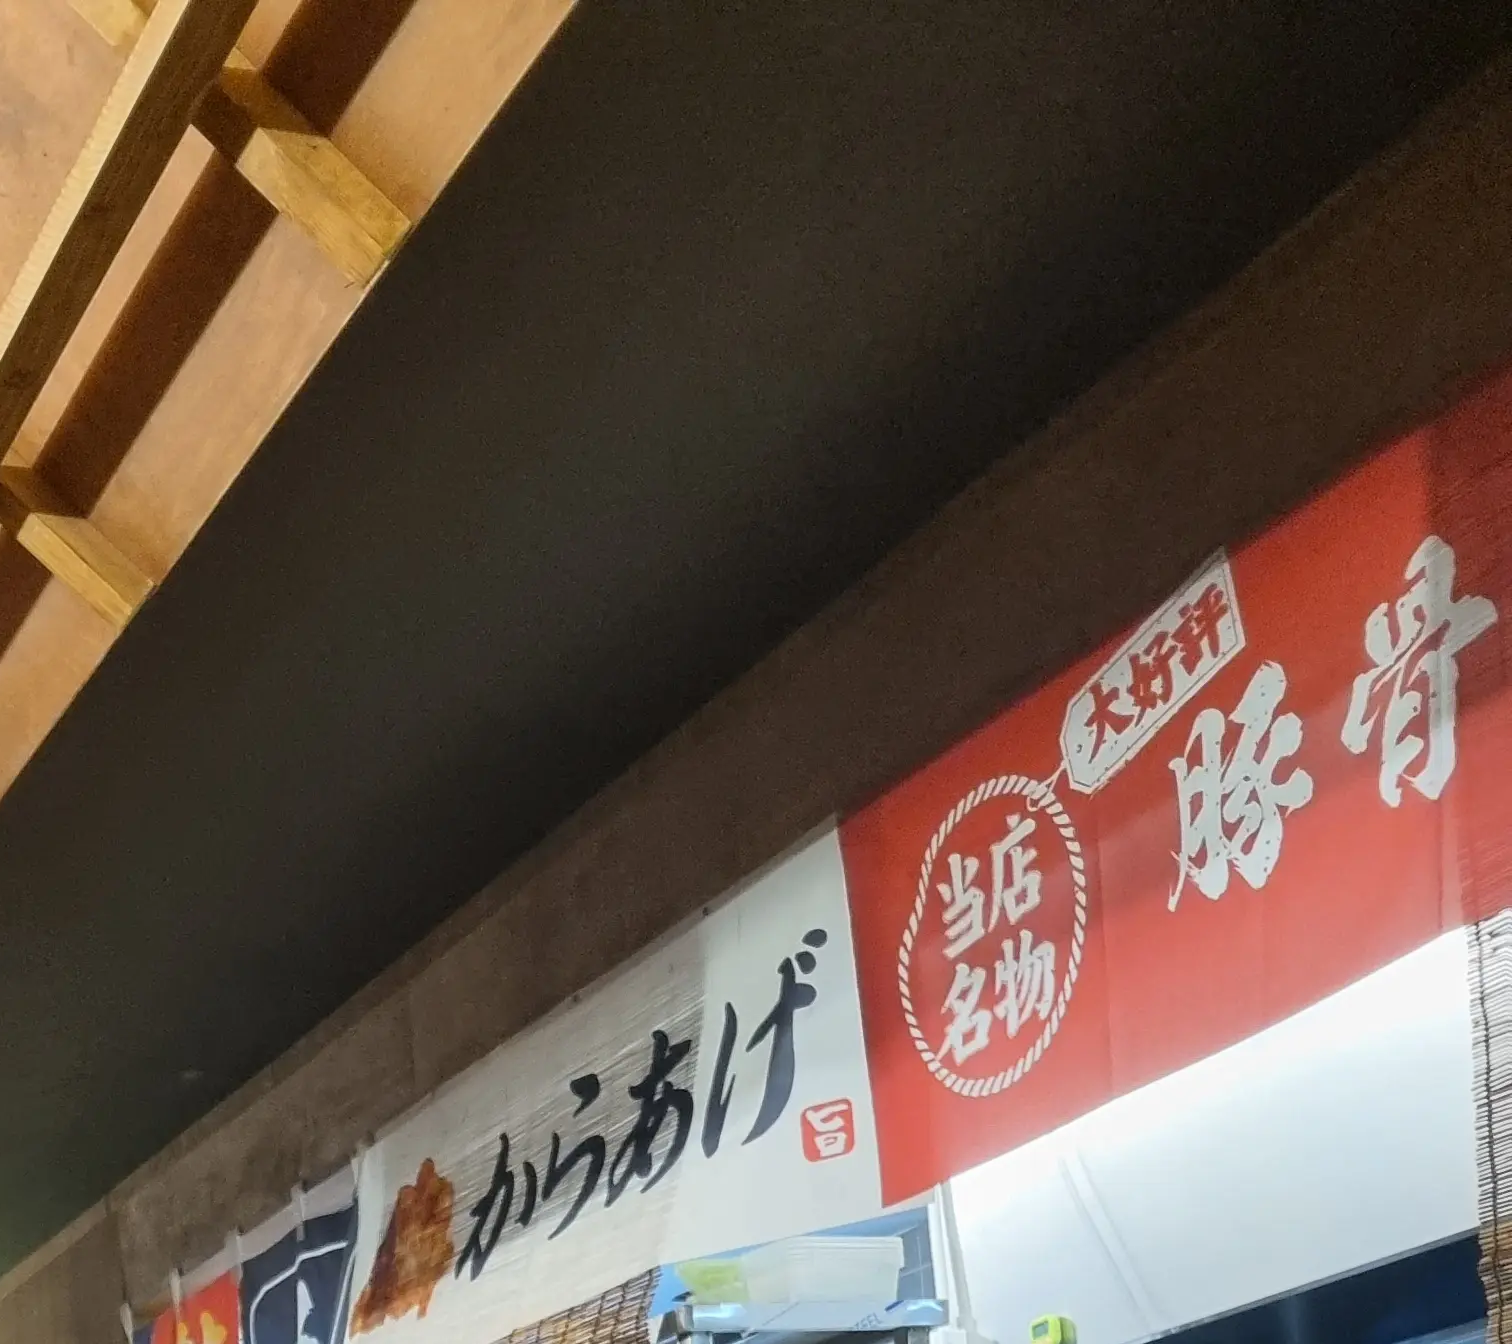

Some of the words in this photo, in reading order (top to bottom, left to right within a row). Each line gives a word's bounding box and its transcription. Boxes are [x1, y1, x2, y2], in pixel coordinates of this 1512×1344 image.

[1084, 582, 1230, 765] 大好評
[1166, 534, 1498, 913] 豚骨
[936, 814, 1044, 960] 当店
[938, 929, 1057, 1067] 名物
[455, 928, 828, 1281] からあげ
[804, 1103, 850, 1159] 旨
